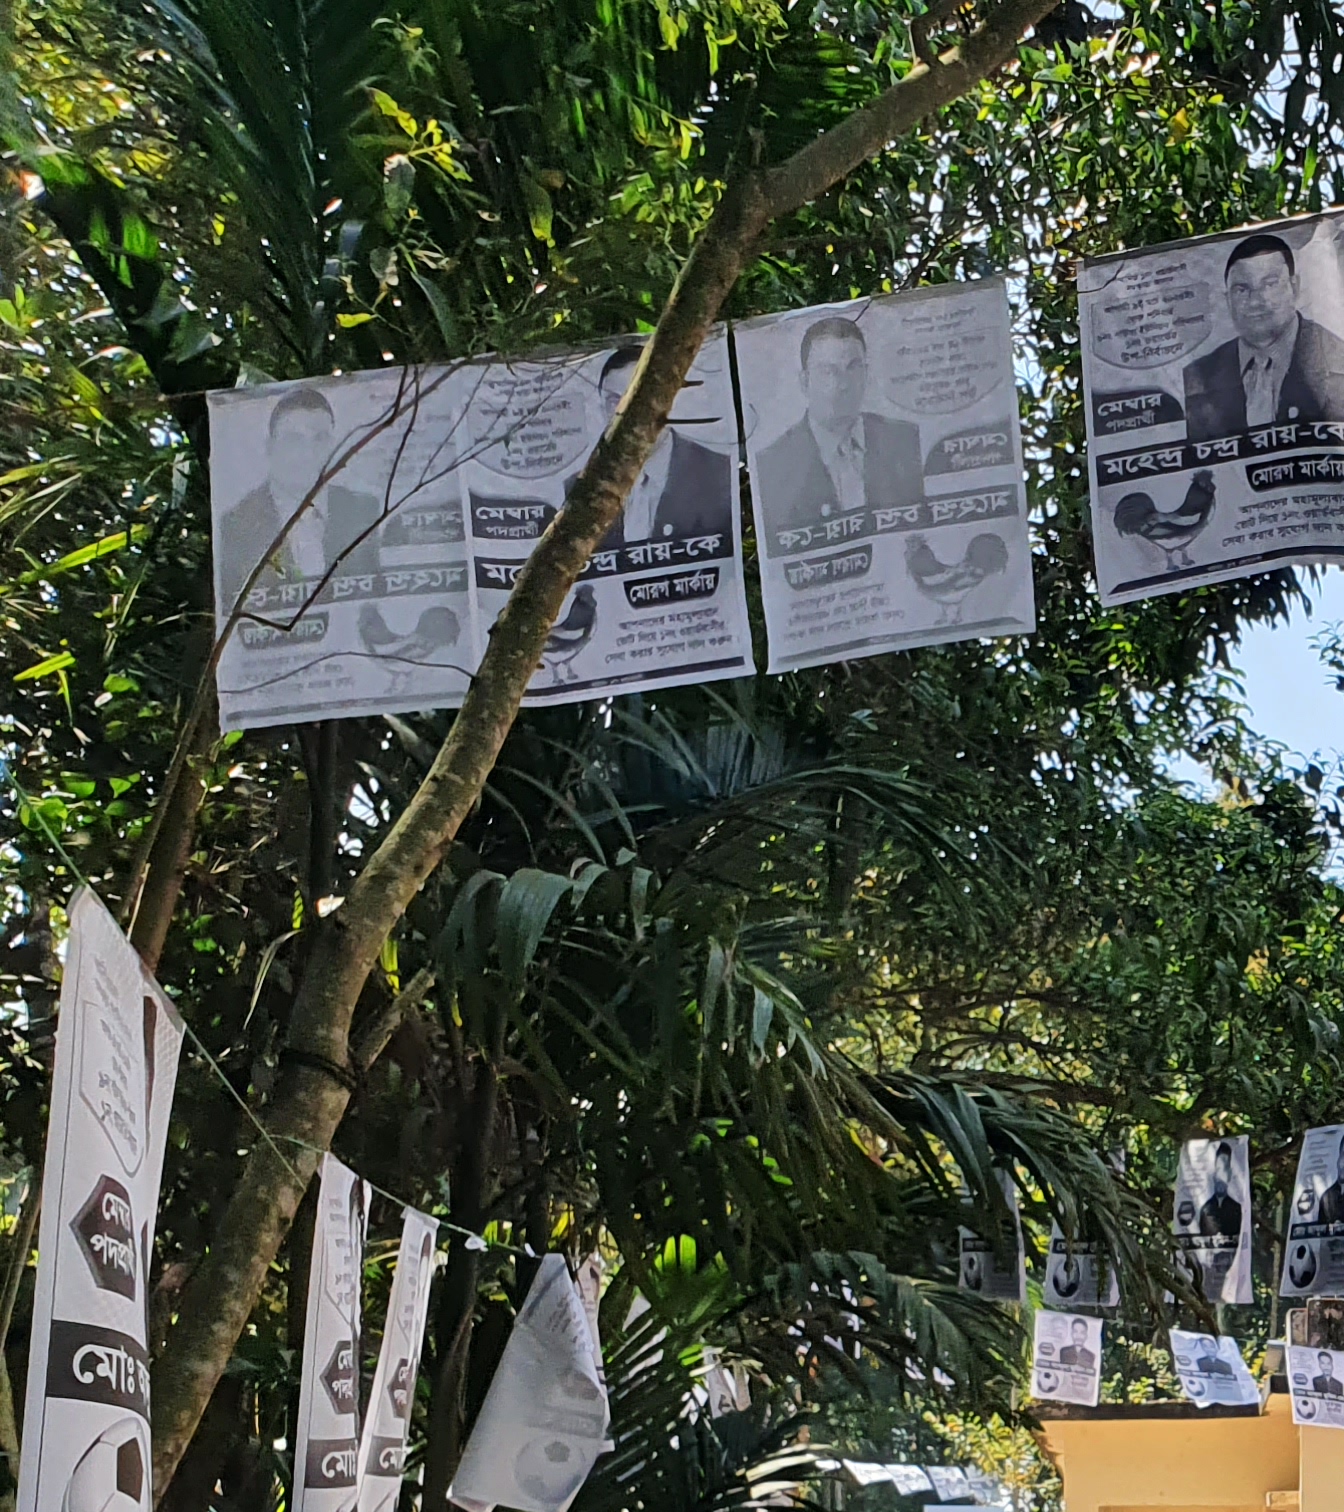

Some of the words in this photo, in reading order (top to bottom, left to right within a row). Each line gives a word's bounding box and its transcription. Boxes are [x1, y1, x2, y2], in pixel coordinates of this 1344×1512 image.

[1103, 446, 1187, 477] মহেন্দ্র
[1193, 435, 1243, 459] চন্দ্র
[1252, 462, 1295, 486] মোরগ
[72, 1342, 136, 1394] মোঃ
